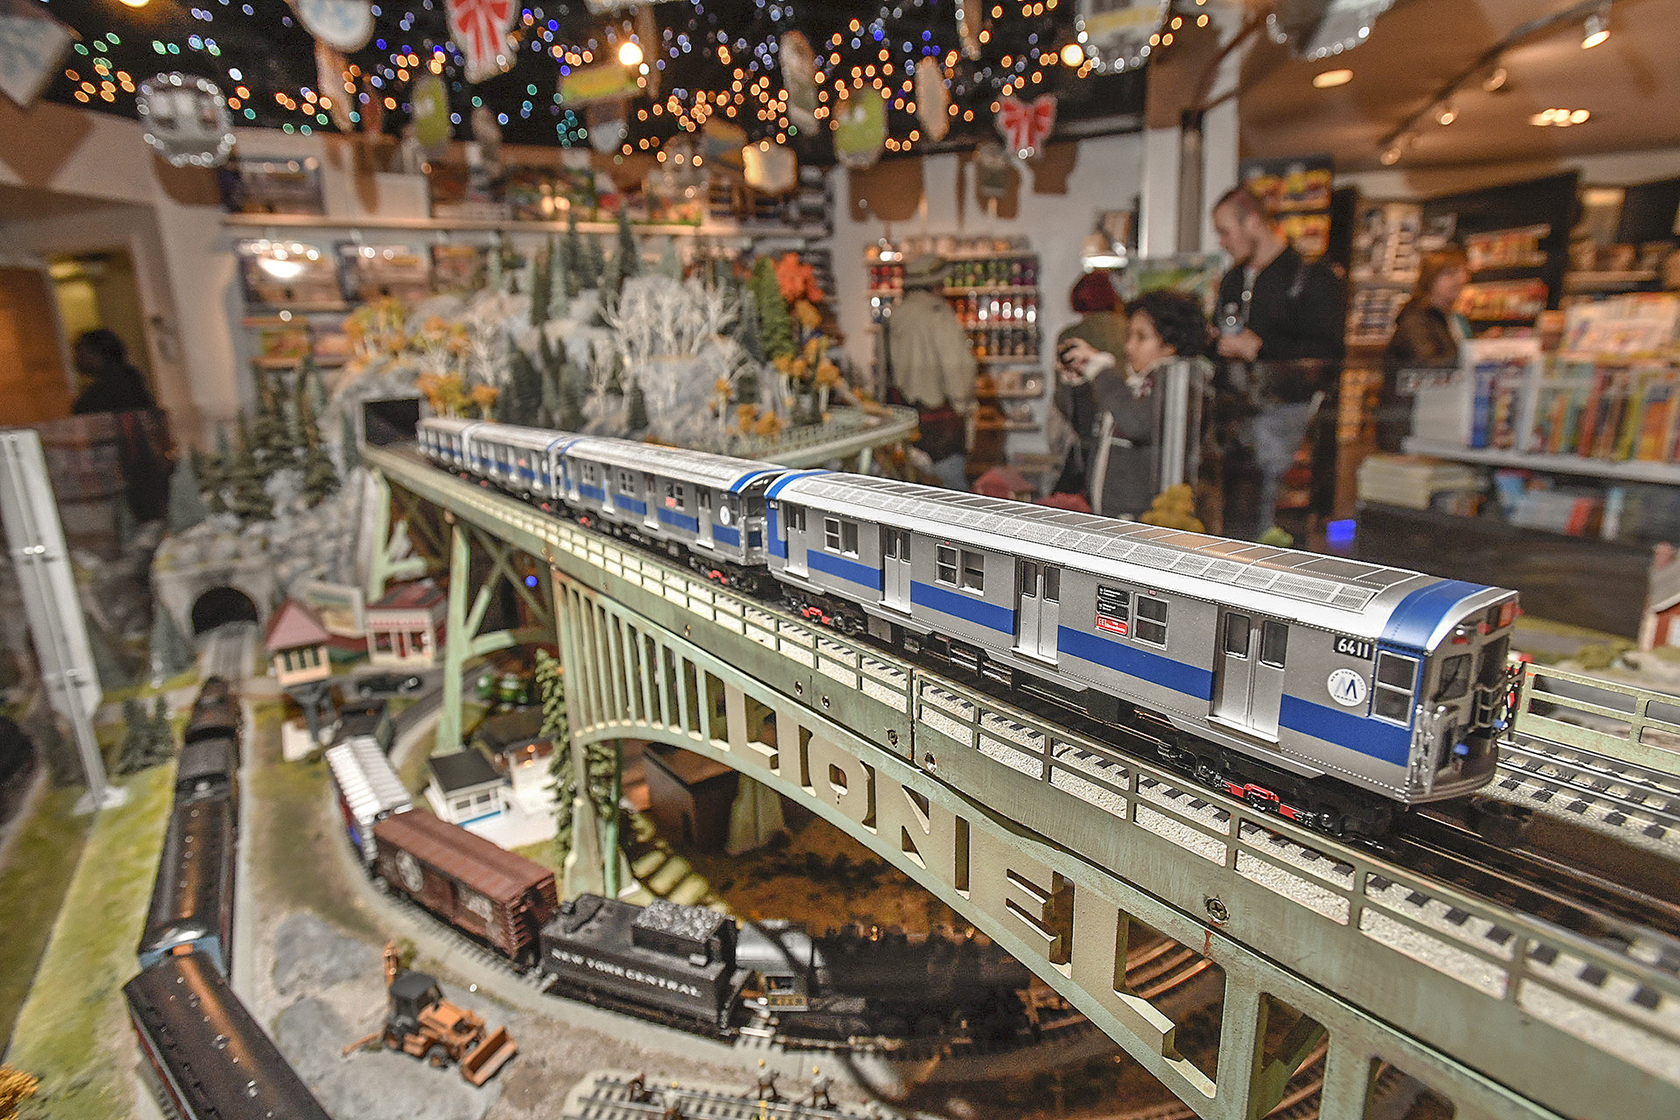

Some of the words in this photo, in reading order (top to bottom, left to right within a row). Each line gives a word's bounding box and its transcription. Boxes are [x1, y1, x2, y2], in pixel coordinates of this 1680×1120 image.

[1338, 638, 1369, 658] 6411
[725, 680, 1172, 1060] LIONEL
[551, 948, 585, 965] NEW
[586, 957, 625, 977] YORK
[625, 968, 702, 988] CENTRAL
